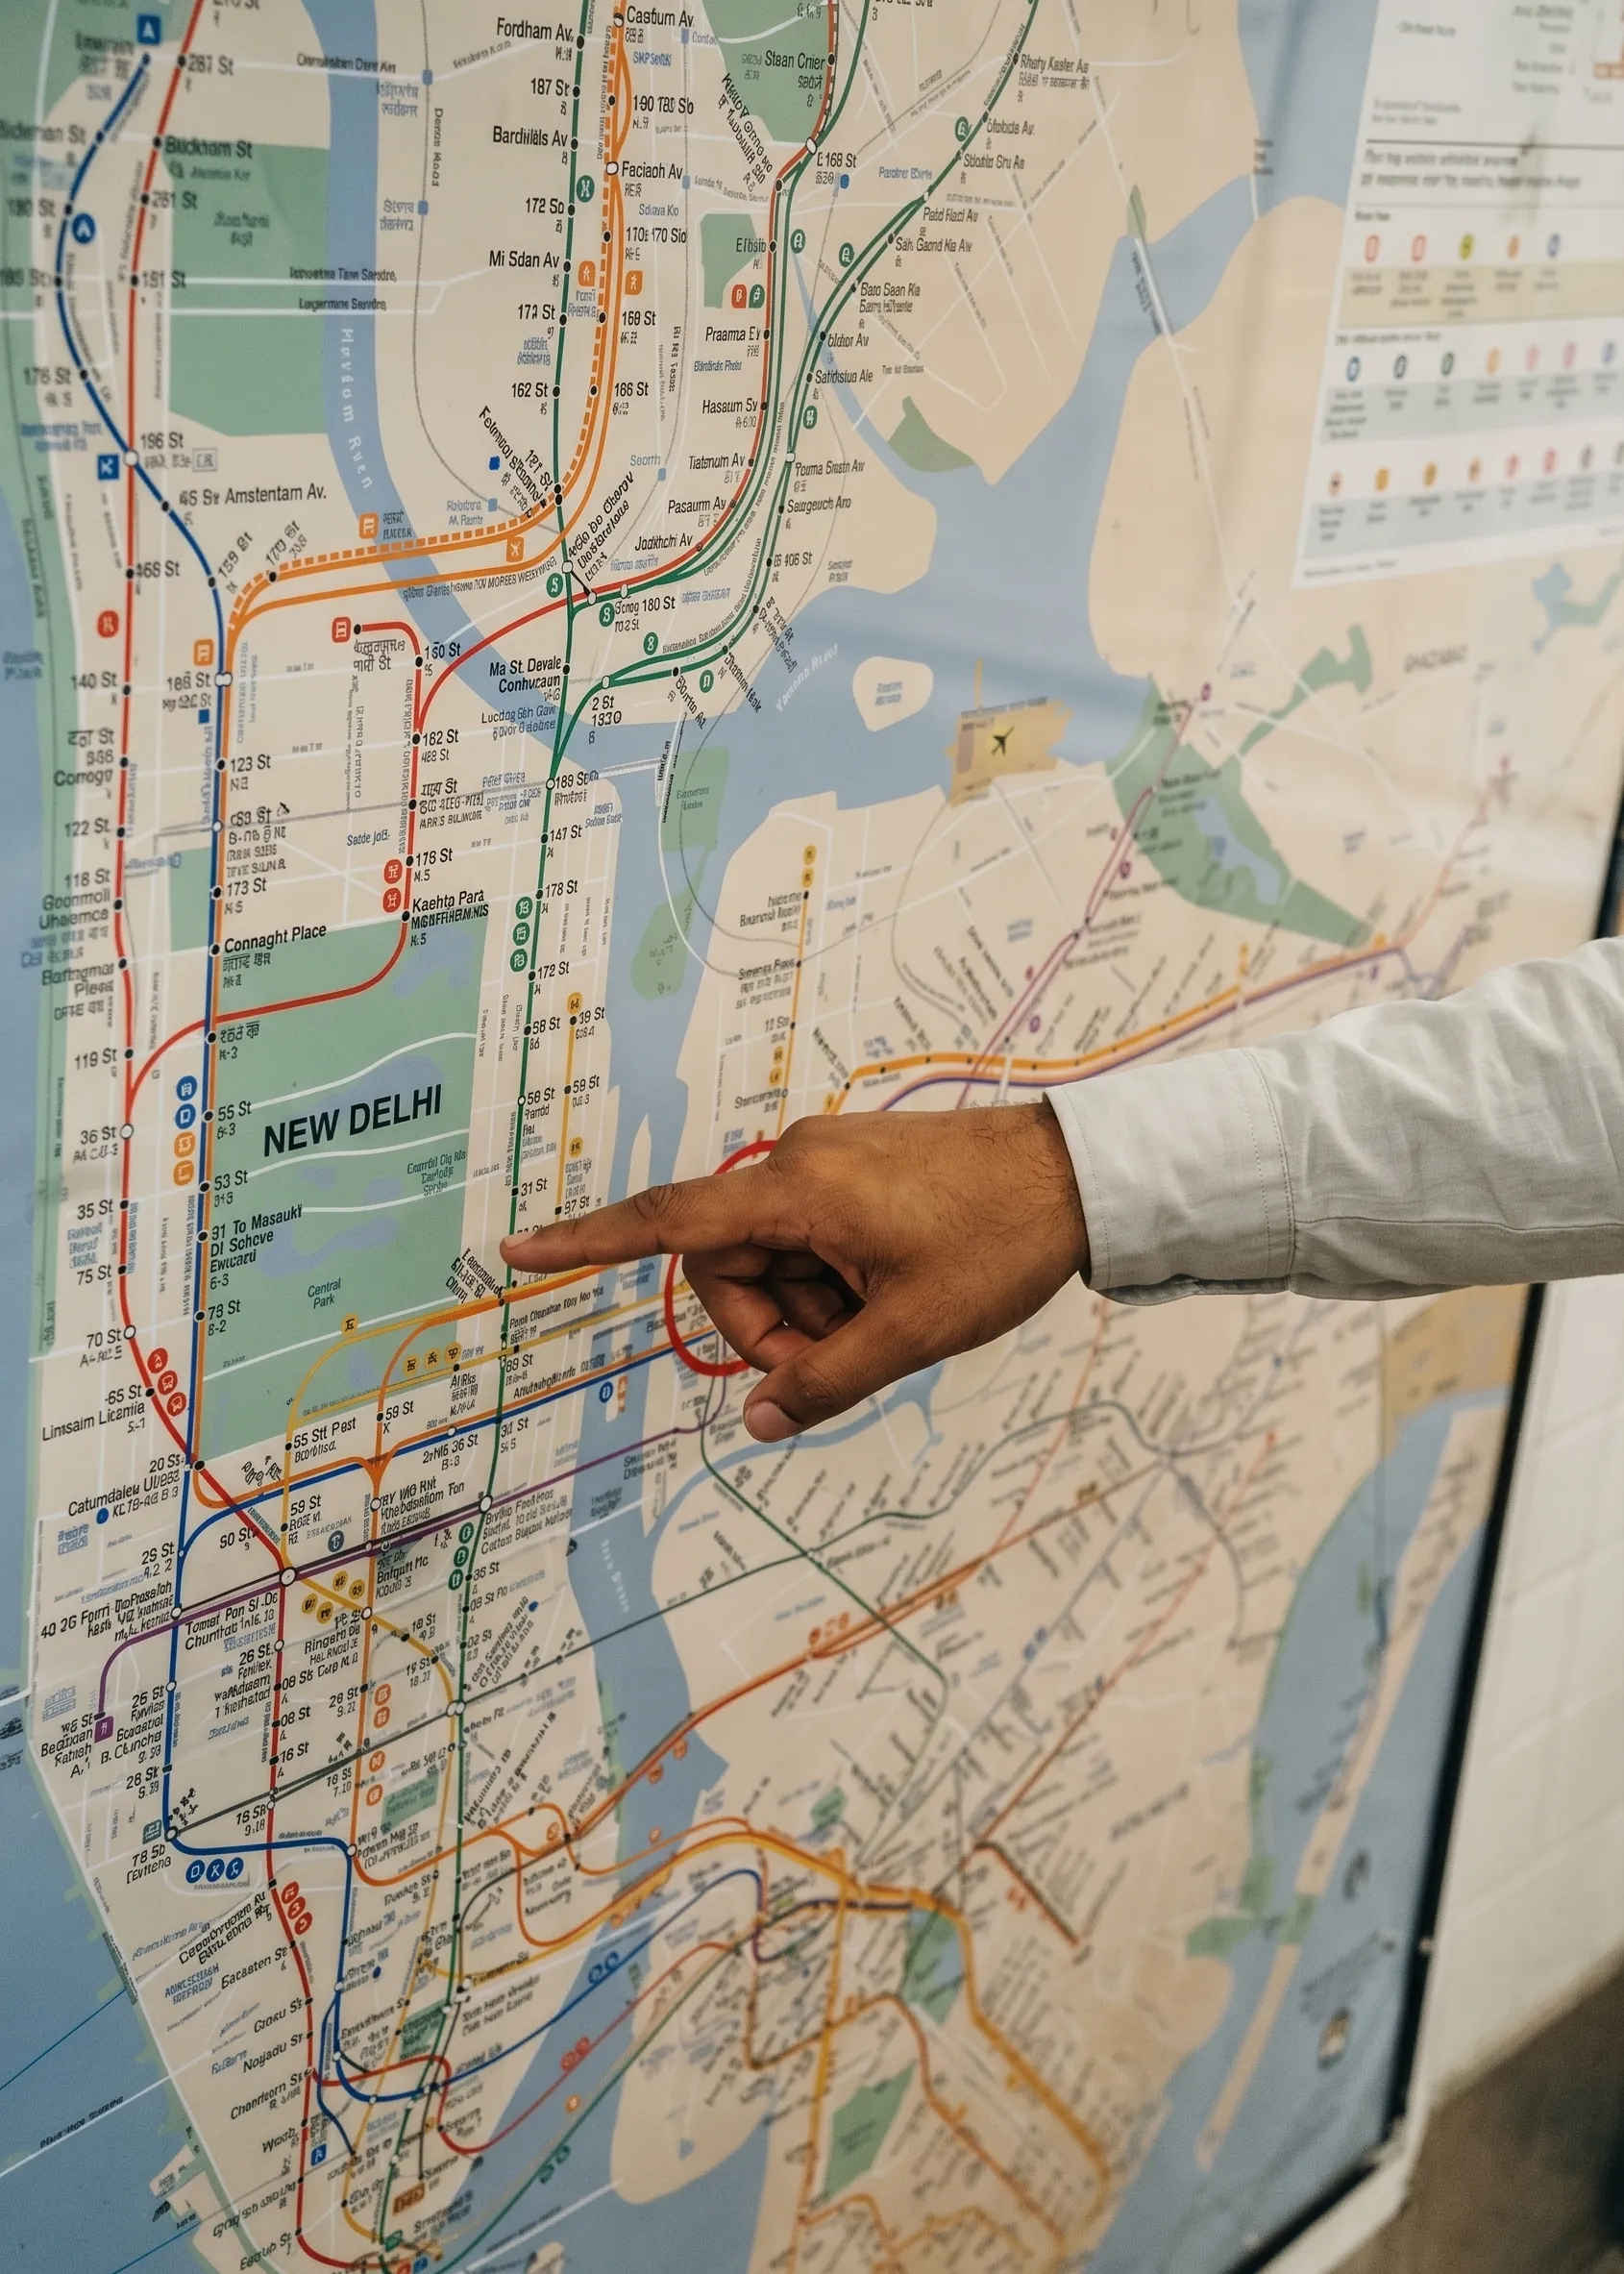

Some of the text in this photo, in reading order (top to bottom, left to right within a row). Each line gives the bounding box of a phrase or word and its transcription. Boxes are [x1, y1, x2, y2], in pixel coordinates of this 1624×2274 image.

[497, 17, 553, 40] Fordham
[218, 57, 234, 76] St
[530, 78, 551, 96] 187
[552, 131, 568, 147] Av
[235, 140, 253, 159] St
[846, 153, 857, 168] St
[668, 162, 683, 177] Av
[38, 198, 55, 217] St
[182, 191, 198, 210] St
[526, 198, 545, 214] 172
[489, 250, 559, 269] Mi Sdan Av
[171, 272, 186, 288] St
[543, 305, 554, 320] St
[644, 311, 655, 326] St
[56, 367, 71, 385] St
[512, 383, 548, 398] 162 St
[636, 383, 649, 397] St
[168, 432, 184, 449] St
[679, 533, 693, 547] Av
[802, 552, 812, 565] St
[164, 560, 180, 577] St
[642, 596, 676, 612] 180 St
[449, 642, 461, 656] St
[490, 662, 507, 677] Ma
[528, 657, 561, 673] Devale
[102, 673, 117, 688] St
[196, 672, 211, 688] St
[446, 729, 459, 743] St
[257, 754, 271, 769] St
[94, 818, 110, 833] St
[571, 825, 582, 838] St
[439, 849, 453, 863] St
[94, 869, 110, 883] St
[253, 878, 267, 893] St
[567, 880, 578, 894] St
[224, 925, 327, 953] Connaght Place
[538, 961, 570, 979] 172 St
[594, 1007, 605, 1021] St
[550, 1017, 561, 1031] St
[102, 1047, 117, 1064] St
[589, 1075, 601, 1089] St
[544, 1088, 555, 1100] St
[238, 1100, 252, 1116] St
[263, 1083, 442, 1158] NEW DELHI
[80, 1126, 116, 1145] 36 St
[214, 1170, 248, 1191] 53 St
[521, 1178, 548, 1195] 31 St
[579, 1196, 590, 1208] St
[77, 1199, 113, 1221] 35 St
[233, 1220, 247, 1235] To
[77, 1265, 112, 1286] 75 St
[308, 1277, 341, 1298] Central
[228, 1299, 241, 1315] St
[312, 1294, 336, 1310] Park
[86, 1328, 122, 1348] 70 St
[522, 1353, 534, 1368] St
[129, 1384, 142, 1399] St
[402, 1400, 415, 1415] St
[517, 1418, 529, 1432] St
[467, 1433, 479, 1447] St
[308, 1495, 322, 1510] St
[161, 1542, 175, 1557] St
[488, 1562, 500, 1575] St
[426, 1613, 436, 1626] St
[347, 1686, 358, 1701] St
[298, 1706, 311, 1720] St
[297, 1742, 309, 1756] St
